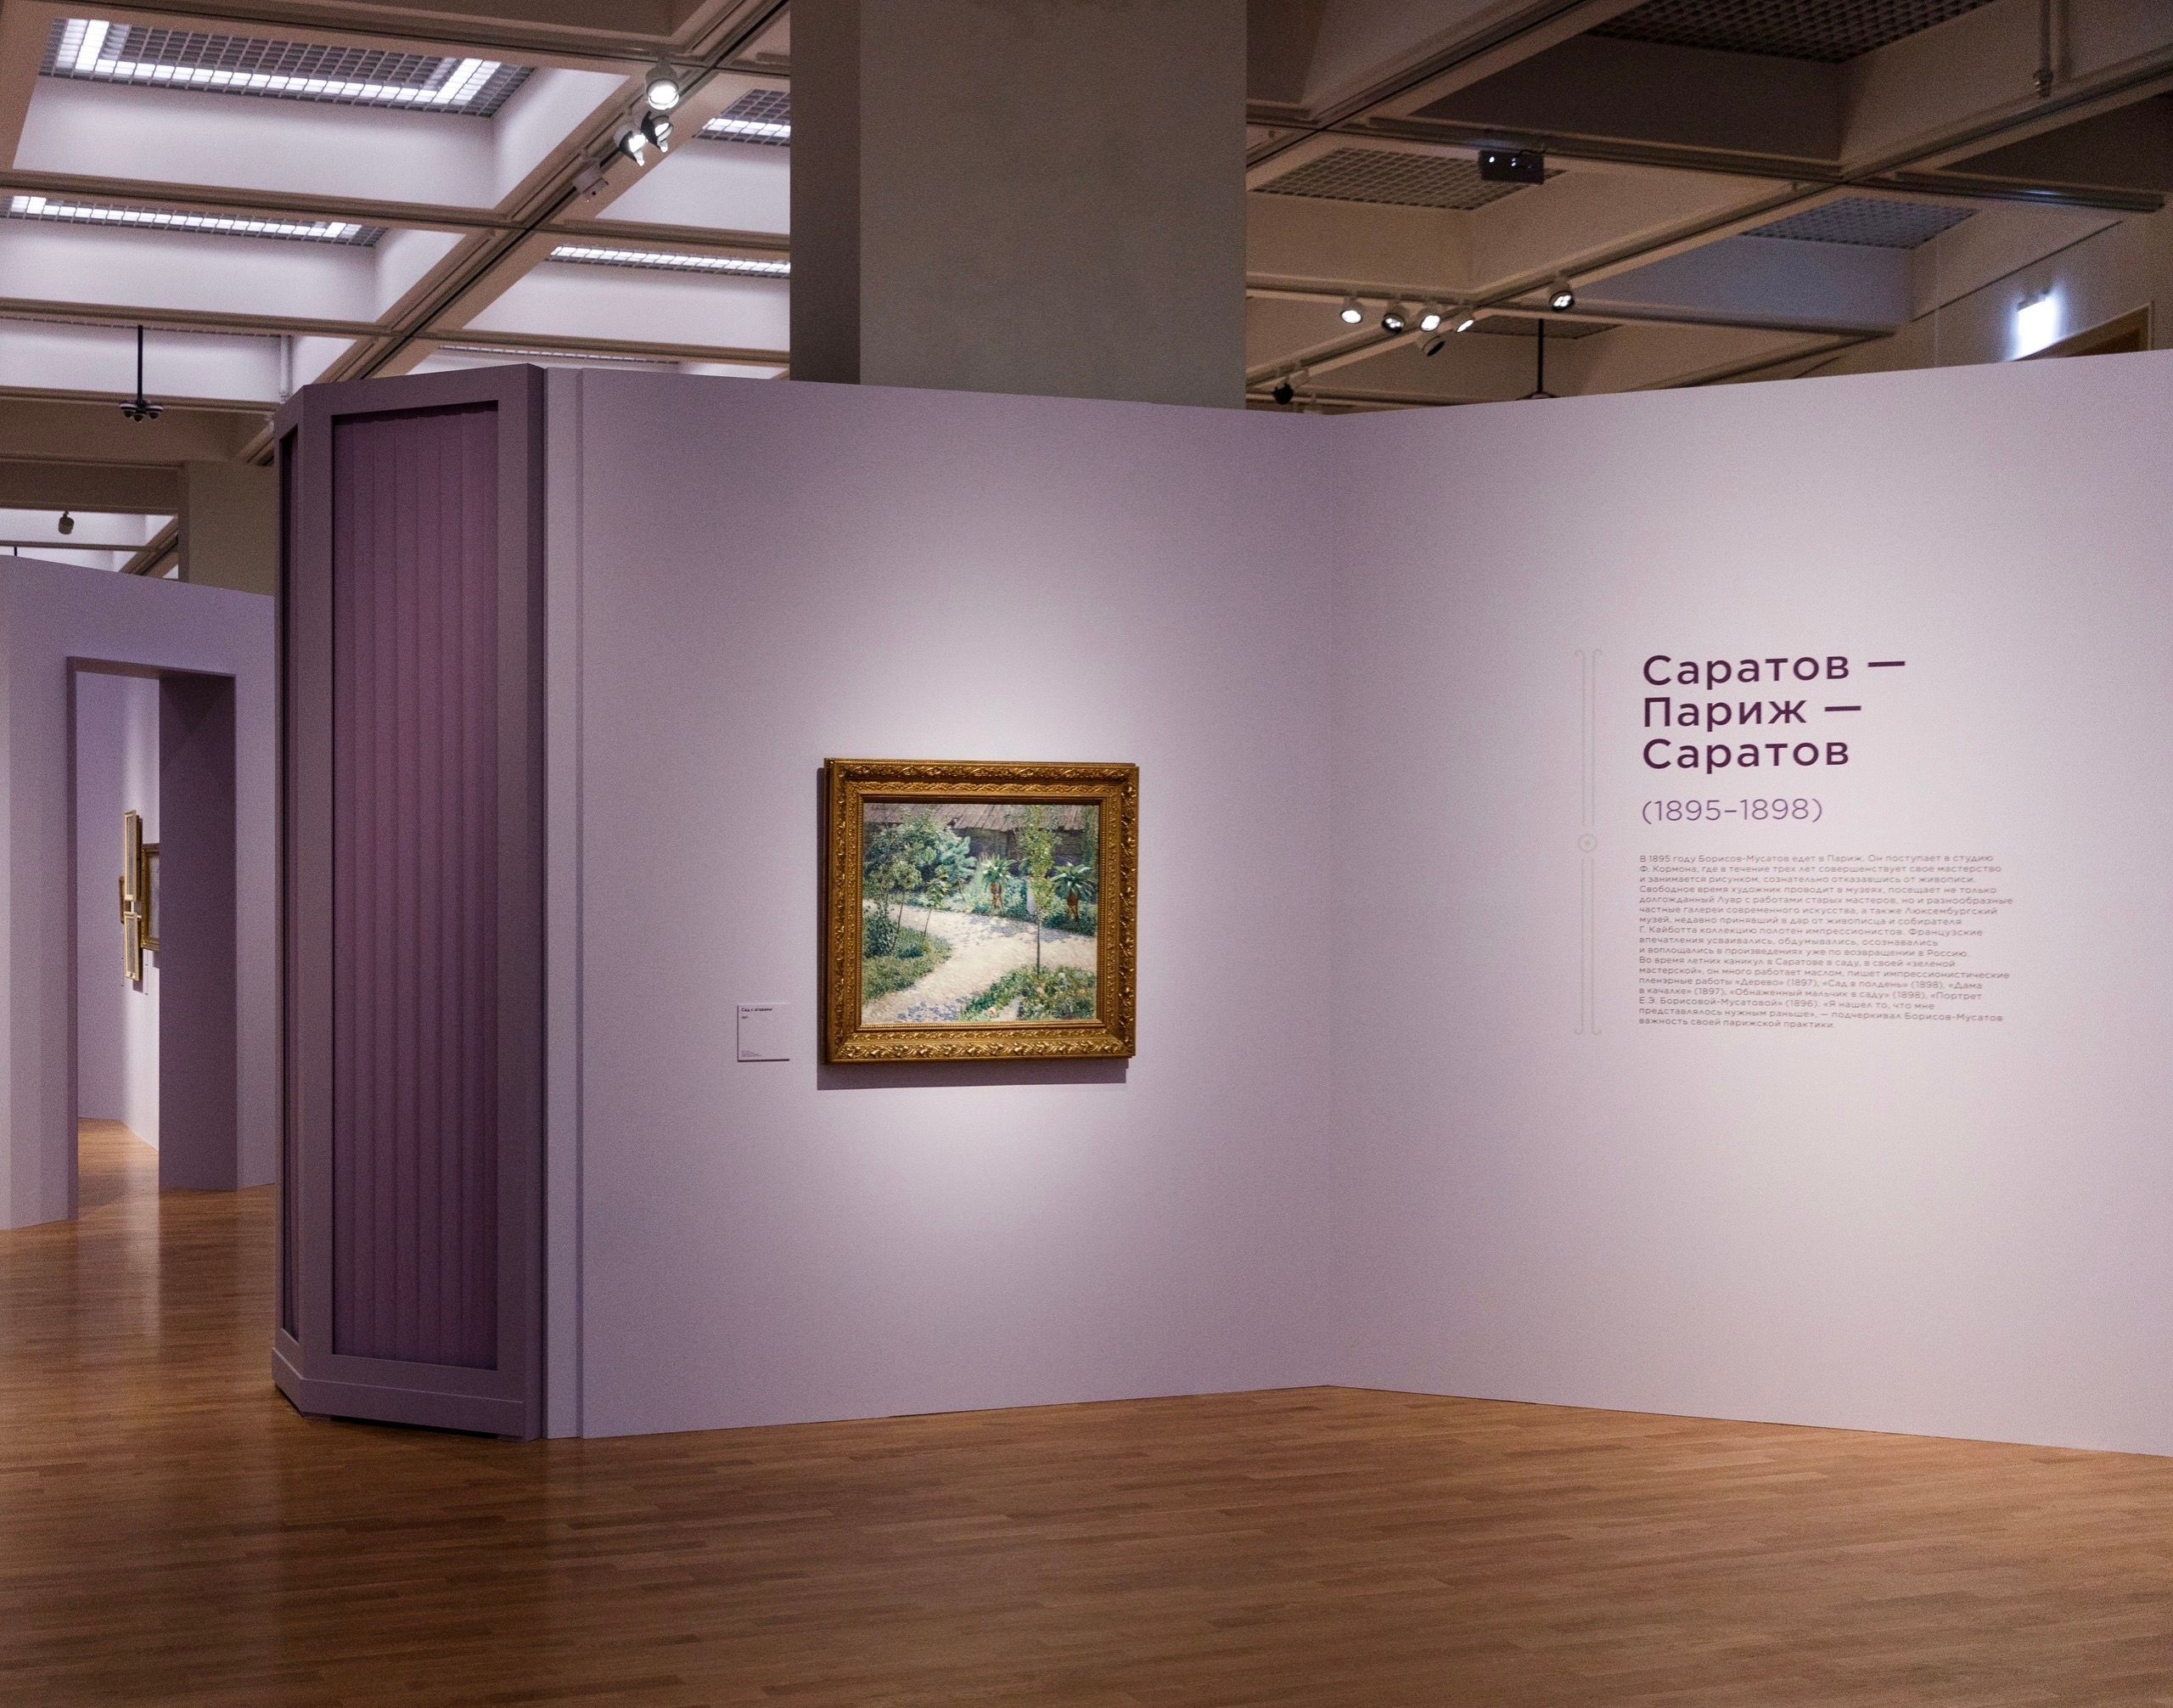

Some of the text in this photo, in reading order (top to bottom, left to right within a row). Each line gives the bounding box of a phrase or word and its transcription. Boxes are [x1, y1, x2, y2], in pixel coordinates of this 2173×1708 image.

[1643, 655, 1849, 690] Саратов
[1644, 697, 1807, 732] Париж
[1643, 738, 1849, 774] Саратов
[1642, 798, 1822, 824] (1895–1898)
[1717, 896, 1742, 904] Лувр
[1926, 896, 2013, 905] разнообразные
[1897, 918, 1962, 926] собирателя
[1907, 928, 1983, 936] Французские
[1775, 958, 1823, 967] Саратове
